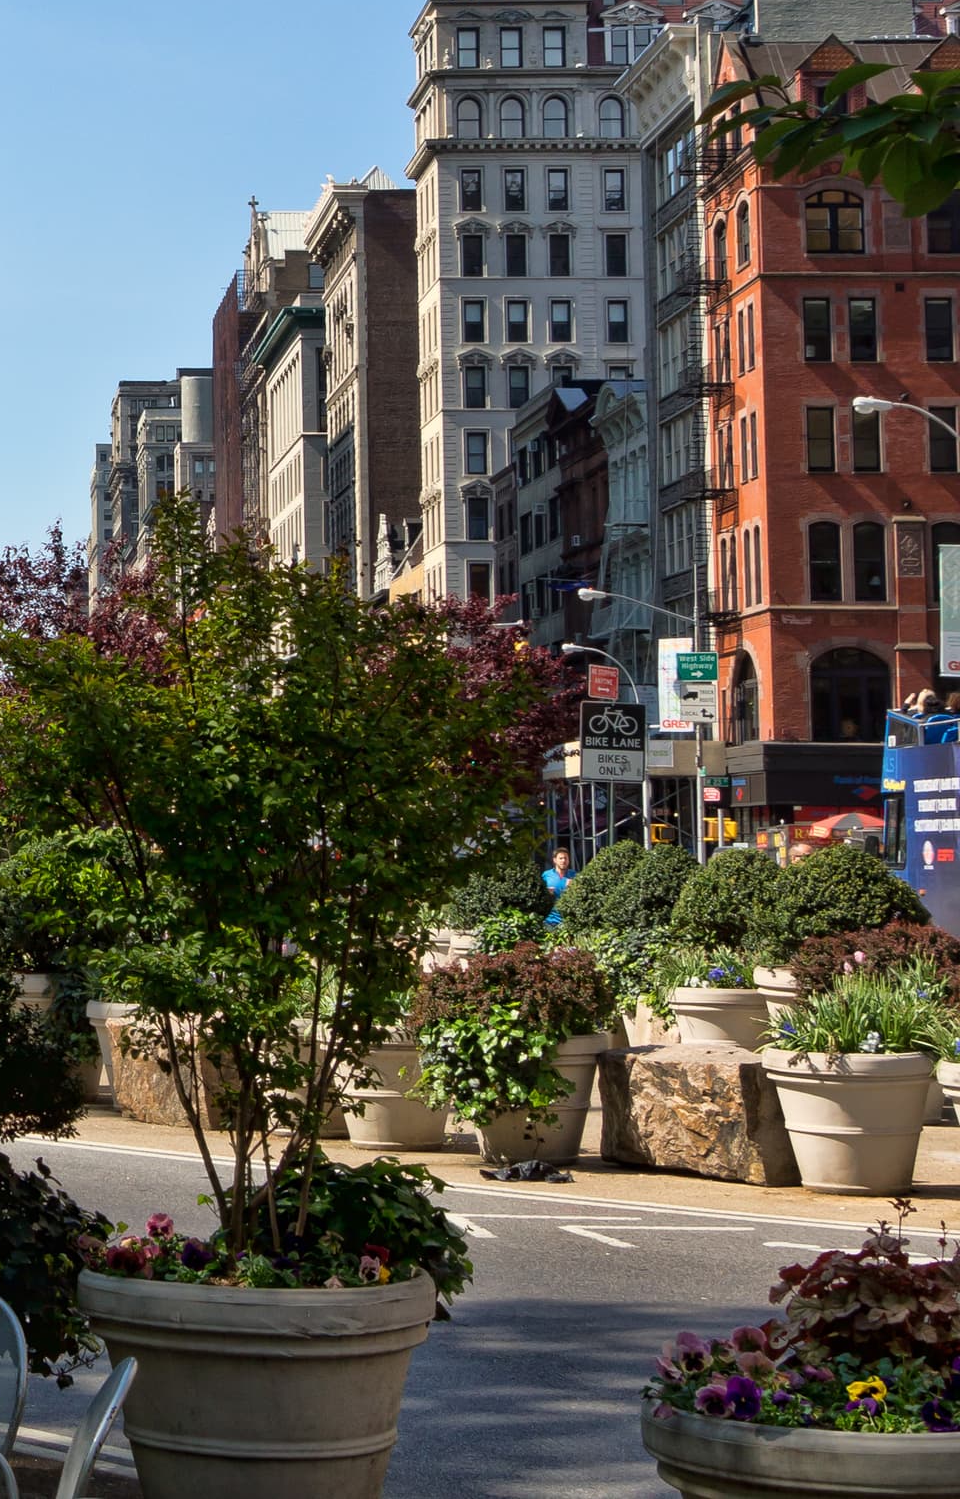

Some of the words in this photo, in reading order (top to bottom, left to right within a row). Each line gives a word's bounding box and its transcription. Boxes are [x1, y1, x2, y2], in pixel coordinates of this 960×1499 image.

[585, 736, 608, 746] BIKE
[612, 737, 640, 748] LANE
[598, 754, 628, 764] BIKES
[598, 766, 626, 776] ONLY
